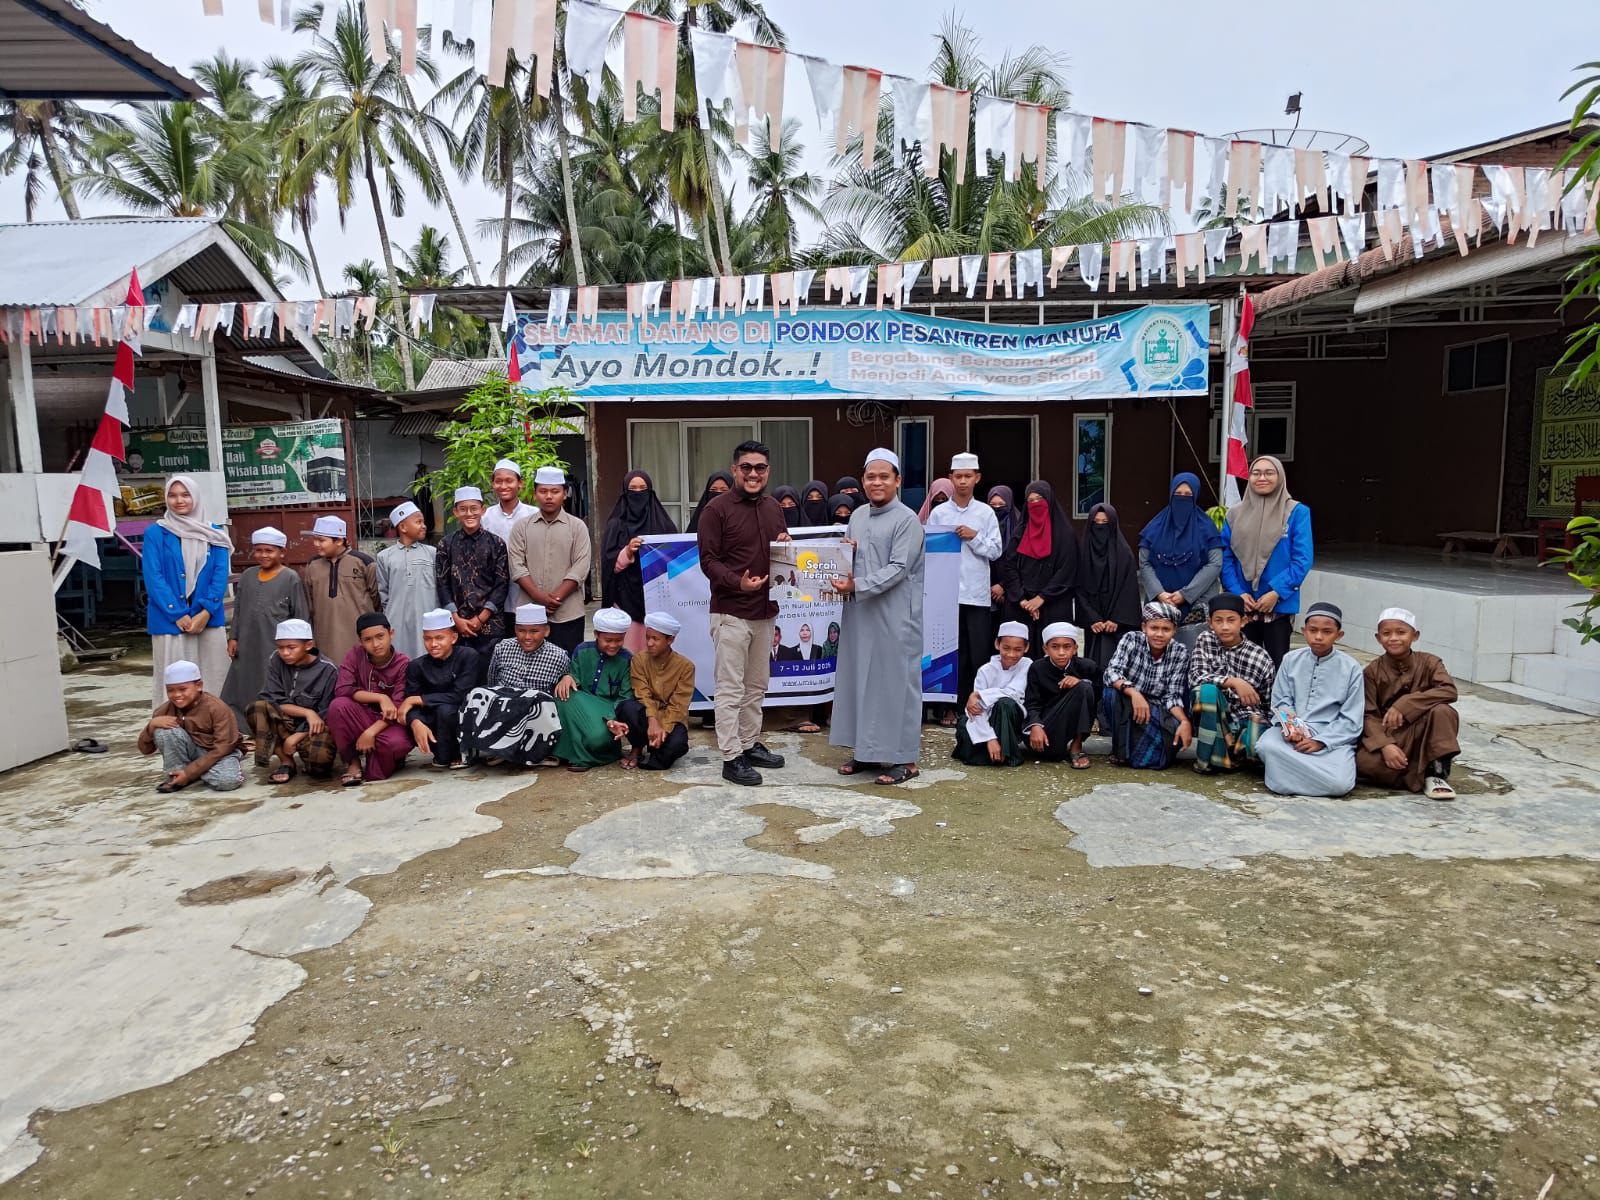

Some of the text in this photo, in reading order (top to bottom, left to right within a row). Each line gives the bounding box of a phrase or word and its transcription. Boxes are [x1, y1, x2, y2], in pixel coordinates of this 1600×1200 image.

[524, 320, 1122, 349] SELAMAT DATANG DI PONDOK PESANTREN MANUFA
[851, 351, 956, 367] Bergabung
[959, 355, 1044, 367] Bersama
[551, 354, 622, 386] Ayo
[851, 368, 1102, 387] Menjadi Anak yang Sholeh
[159, 454, 189, 467] Umroh
[226, 452, 245, 463] Haji
[227, 463, 287, 477] Wisata Halal
[806, 559, 837, 570] Serah
[803, 570, 839, 580] Terima
[792, 664, 800, 672] 12
[802, 663, 815, 671] Juli
